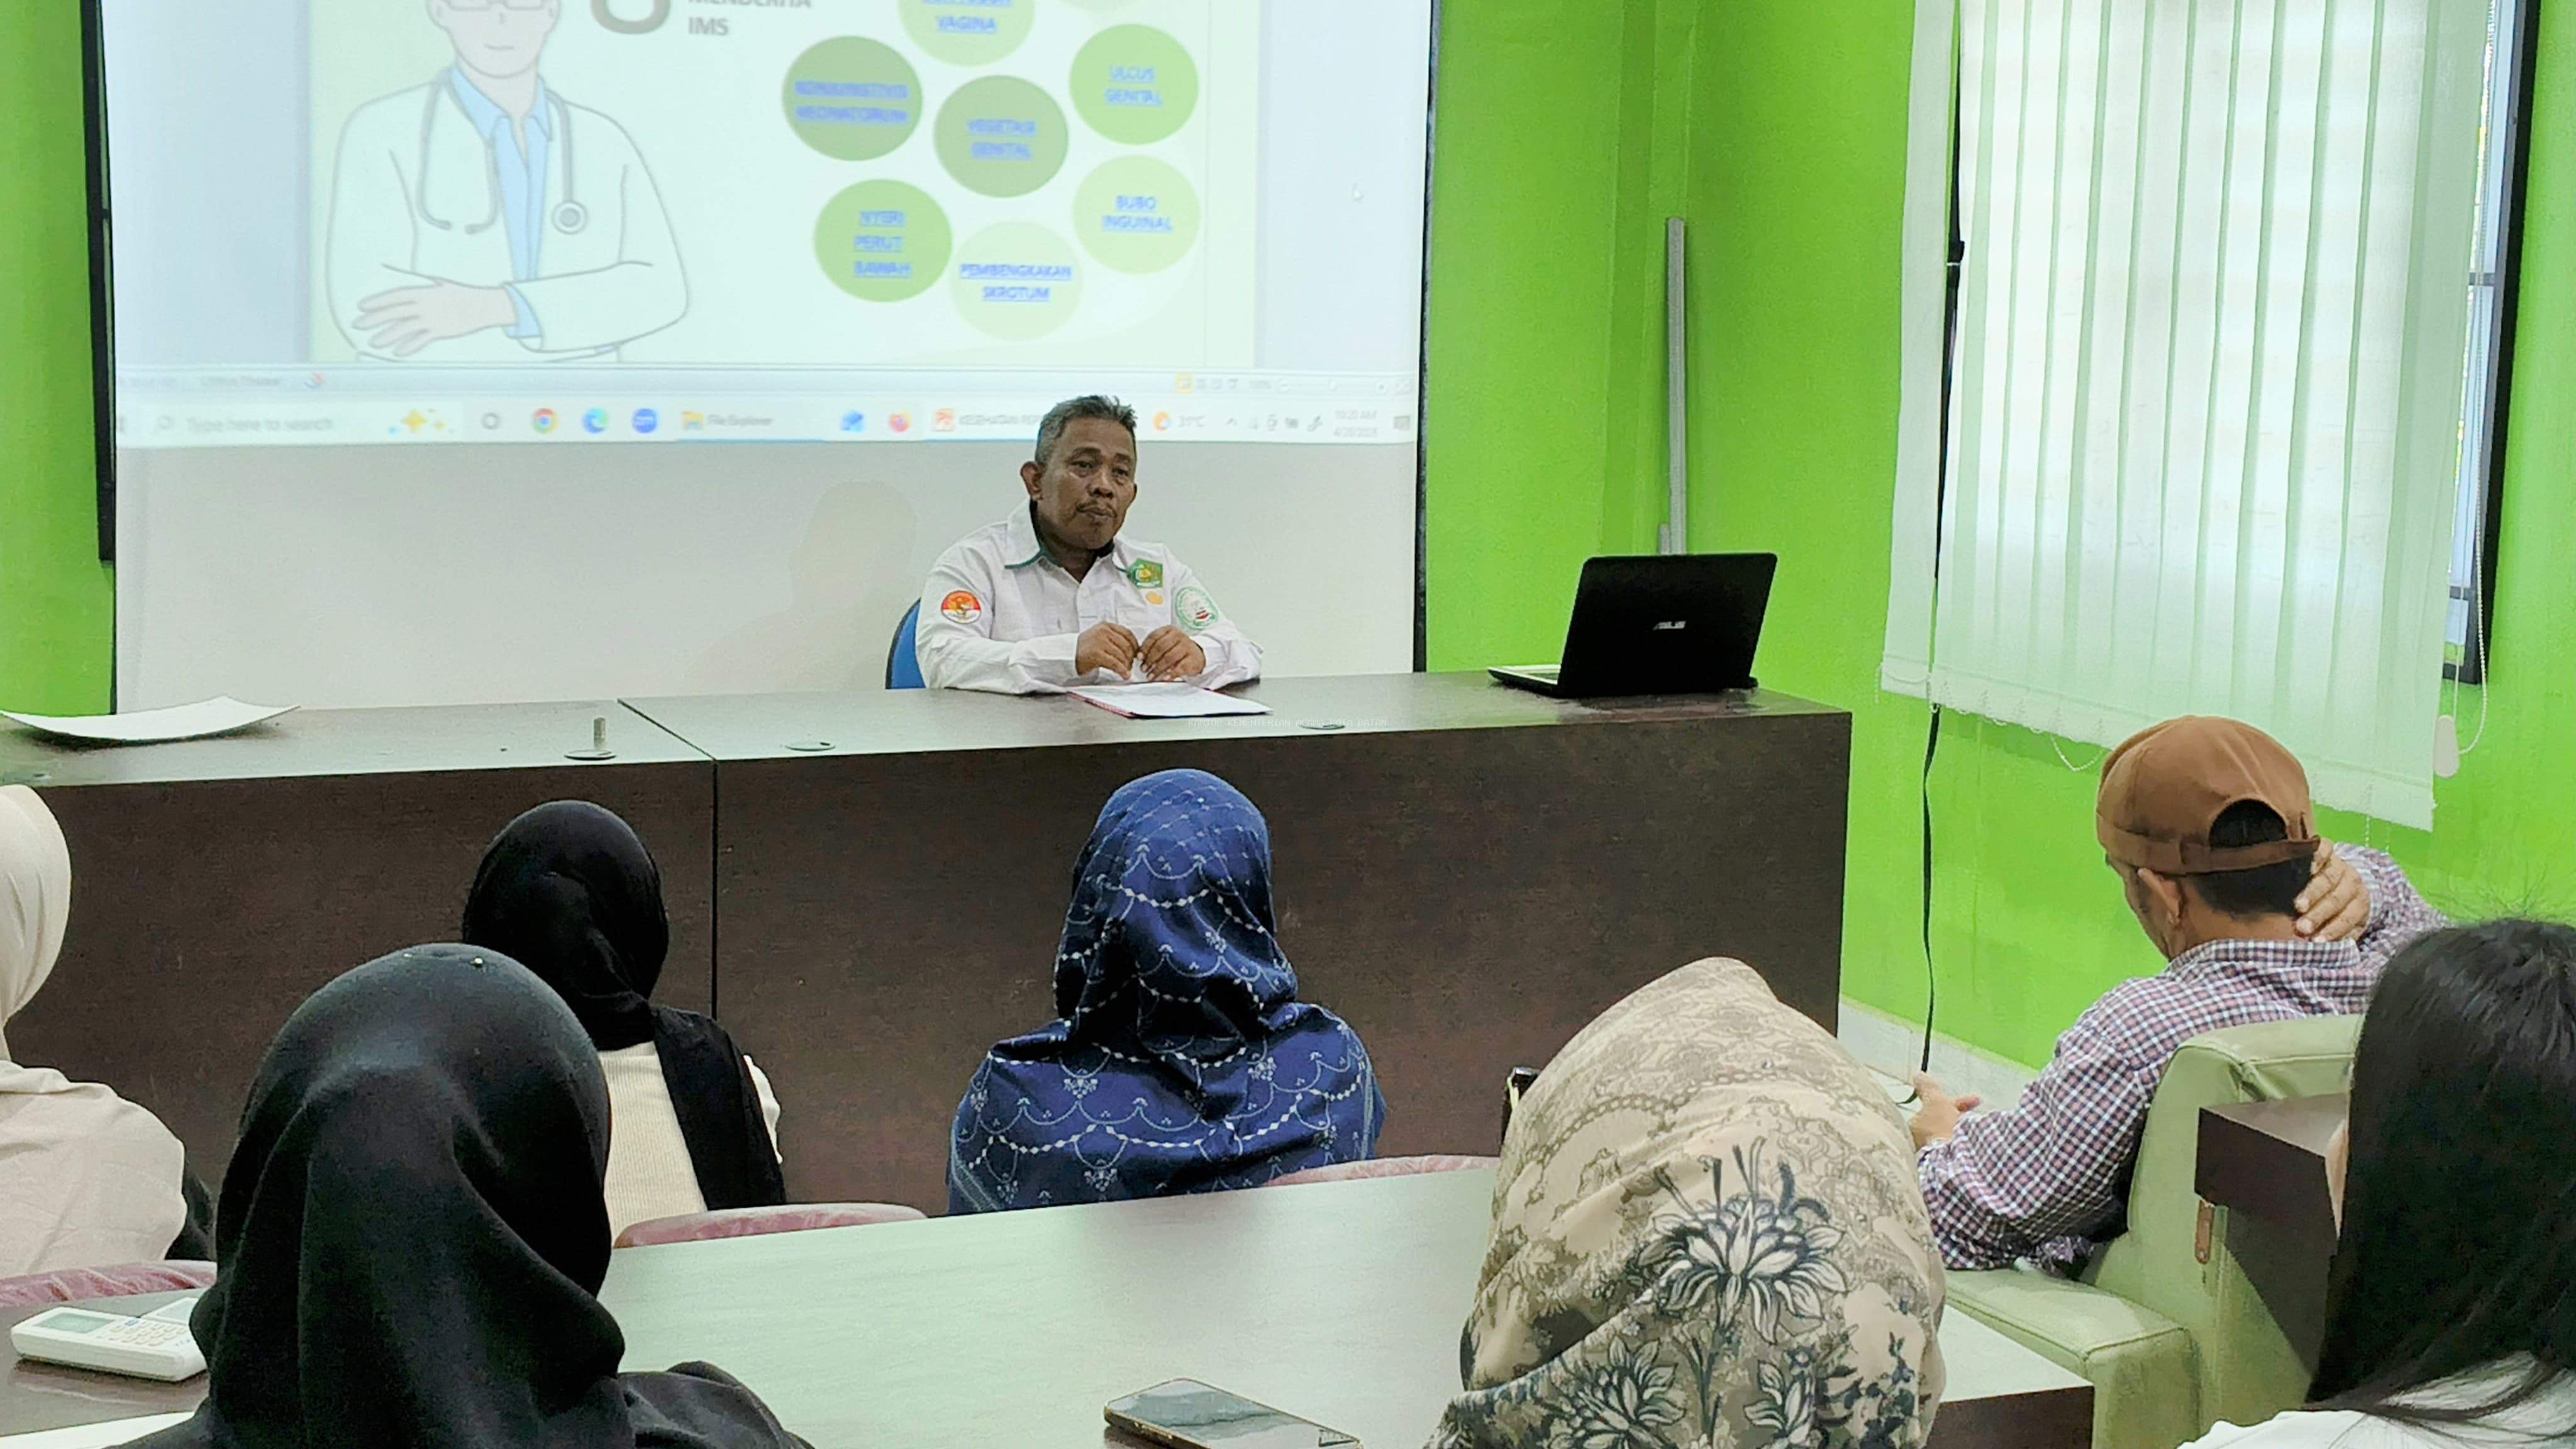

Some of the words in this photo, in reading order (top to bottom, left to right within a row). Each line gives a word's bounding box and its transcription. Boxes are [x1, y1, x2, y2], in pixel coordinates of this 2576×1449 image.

[689, 17, 728, 35] IMS
[936, 16, 997, 32] VAGINA
[1109, 67, 1155, 83] ULCUS
[1116, 196, 1157, 211] BUBO
[1102, 216, 1174, 232] INGUINAL
[854, 235, 903, 252] PERUT
[960, 264, 1073, 280] PEMBENGKAKAN
[982, 287, 1050, 302] SKROTUM
[1654, 620, 1687, 630] ASUS
